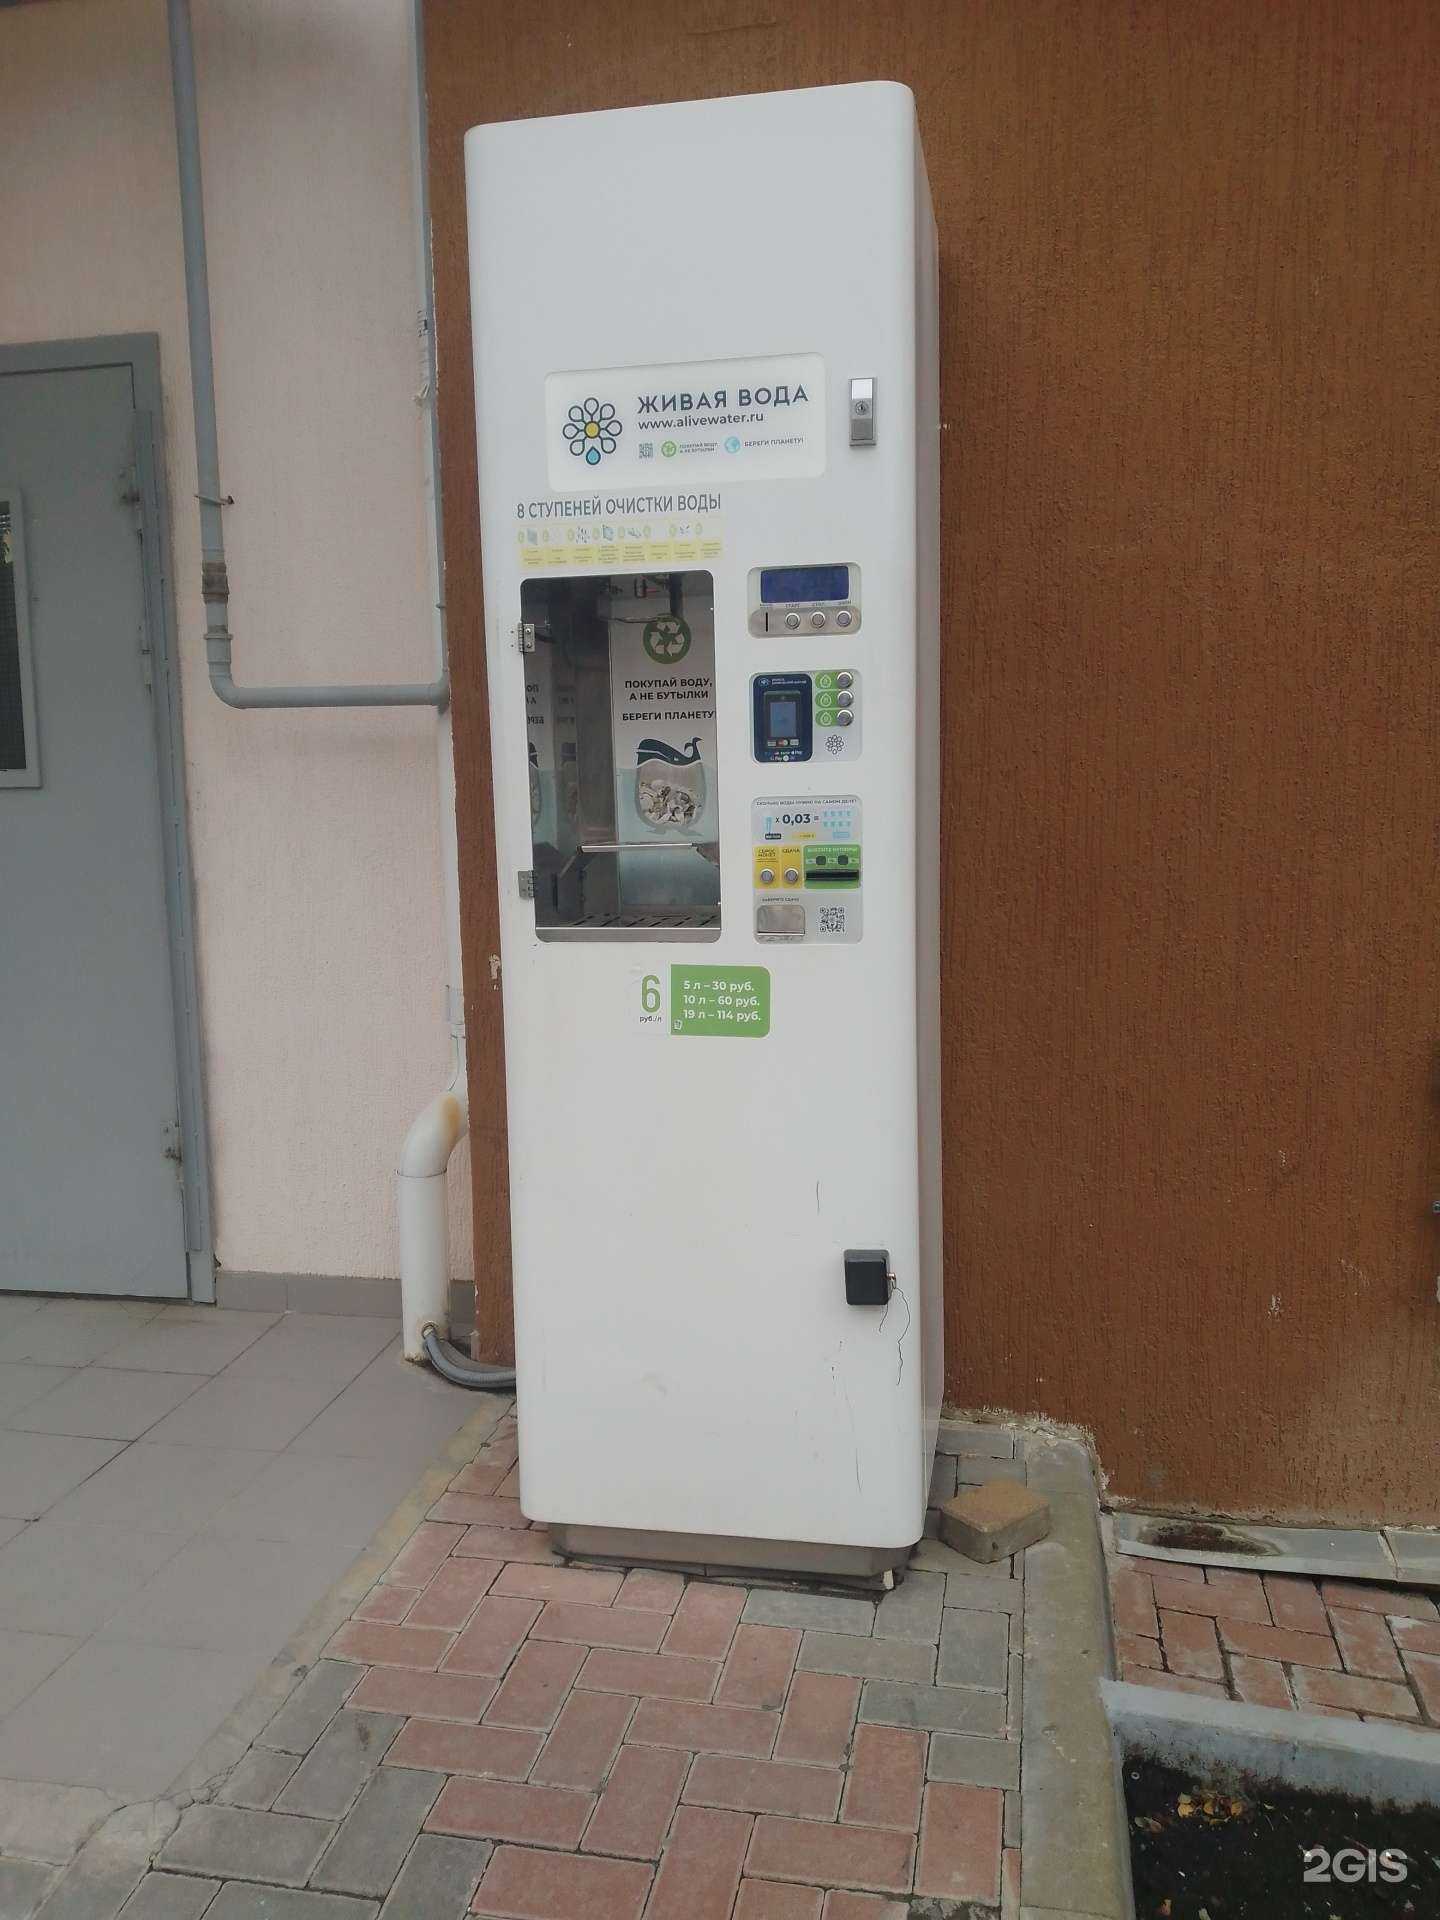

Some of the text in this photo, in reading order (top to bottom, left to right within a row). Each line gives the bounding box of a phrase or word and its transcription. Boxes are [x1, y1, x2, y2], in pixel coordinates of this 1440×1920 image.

[637, 385, 809, 414] ЖИВАЯ ВОДА
[638, 412, 764, 430] www.alivewater.ru
[516, 494, 721, 519] 8 СТУПЕНЕЙ ОЧИСТКИ ВОДЫ
[625, 678, 712, 688] ПОКУПАЙ ВОДУ,
[630, 692, 637, 700] А
[656, 691, 708, 700] БУТЫЛКИ
[622, 712, 662, 720] БЕРЕГИ
[782, 814, 810, 826] 0,03
[684, 981, 690, 990] 5
[712, 981, 726, 990] 30
[730, 982, 754, 992] руб.
[642, 974, 660, 1013] 6
[684, 995, 696, 1004] 10
[718, 996, 732, 1006] 60
[736, 996, 760, 1007] руб.
[684, 1010, 696, 1019] 19
[698, 1011, 706, 1019] л
[716, 1010, 734, 1020] 114
[736, 1011, 761, 1022] руб.
